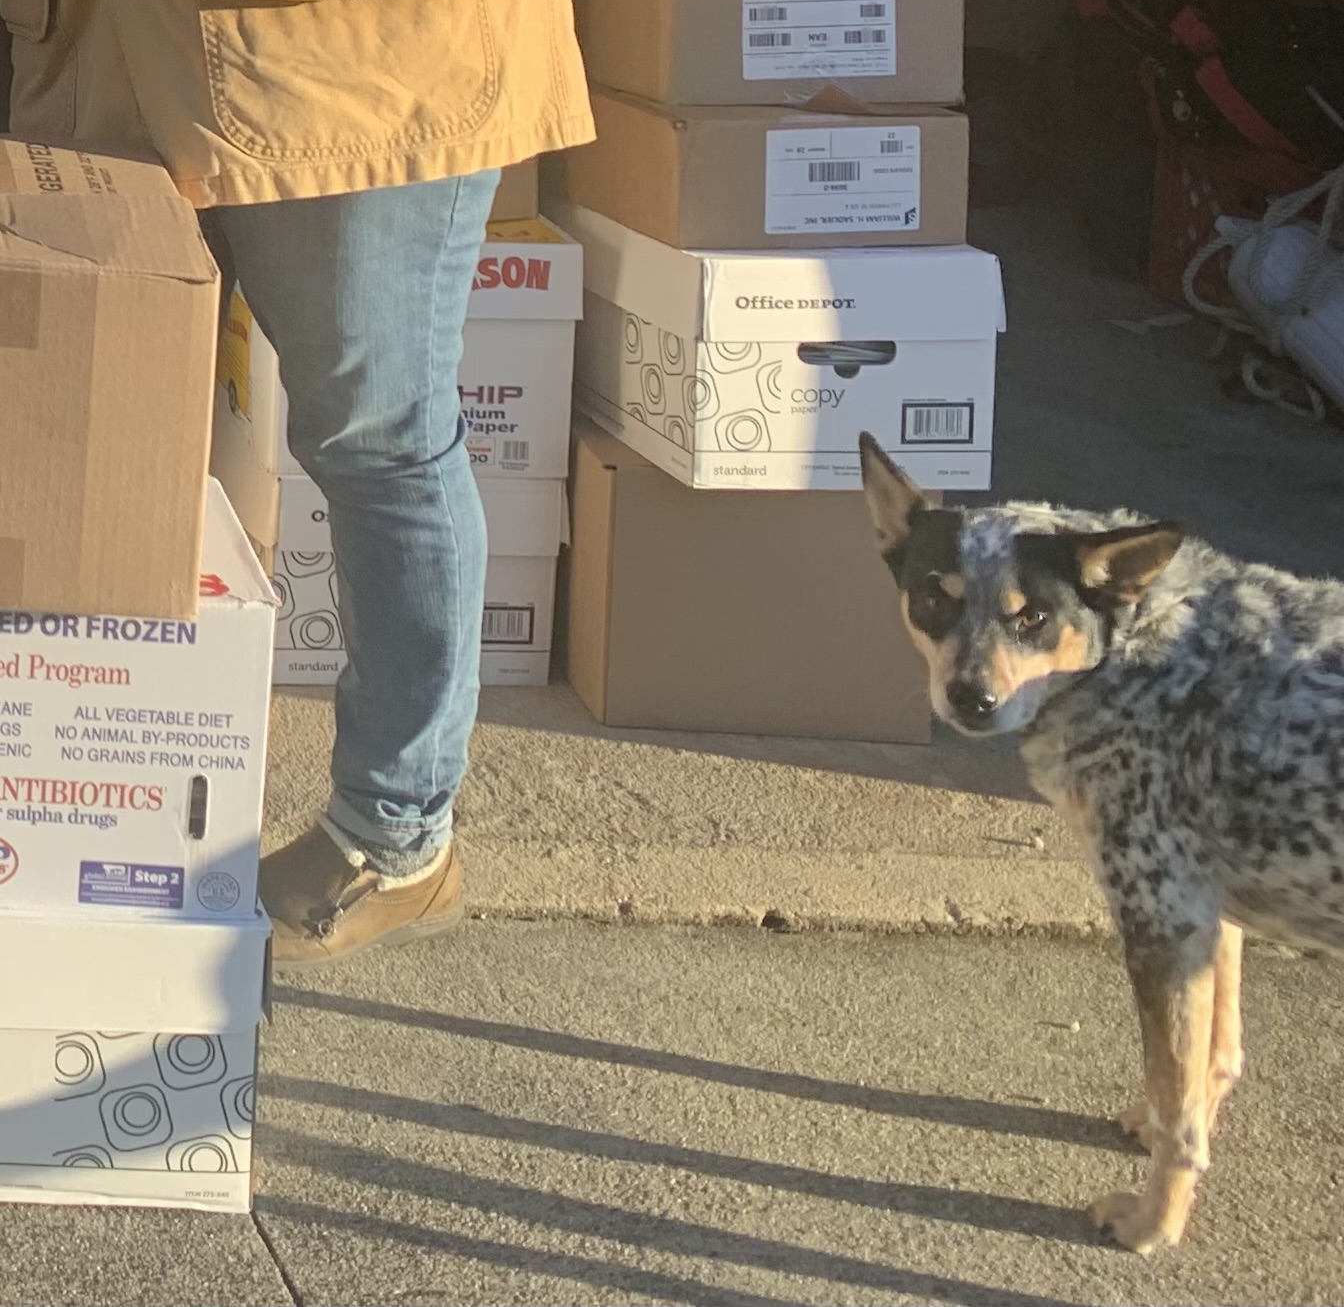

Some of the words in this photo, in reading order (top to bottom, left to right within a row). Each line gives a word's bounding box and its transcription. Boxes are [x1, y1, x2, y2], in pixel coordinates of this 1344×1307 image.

[736, 296, 793, 310] Office
[797, 298, 855, 309] DEPOT
[791, 387, 845, 407] copy
[791, 404, 818, 415] paper
[713, 465, 767, 476] standard
[40, 613, 79, 638] OR
[85, 616, 197, 646] FROZEN
[28, 654, 131, 689] Program
[288, 660, 339, 672] standard
[74, 706, 101, 721] ALL
[105, 707, 195, 726] VEGETABLE
[198, 713, 233, 729] DIET
[55, 725, 77, 740] NO
[81, 727, 138, 744] ANIMAL
[142, 730, 250, 750] BY-PRODUCTS
[61, 746, 84, 761] NO
[87, 747, 146, 765] GRAINS
[150, 751, 194, 768] FROM
[198, 754, 246, 771] CHINA
[7, 802, 63, 826] sulpha
[67, 808, 118, 828] drugs
[134, 869, 168, 886] Step
[169, 872, 179, 884] 2
